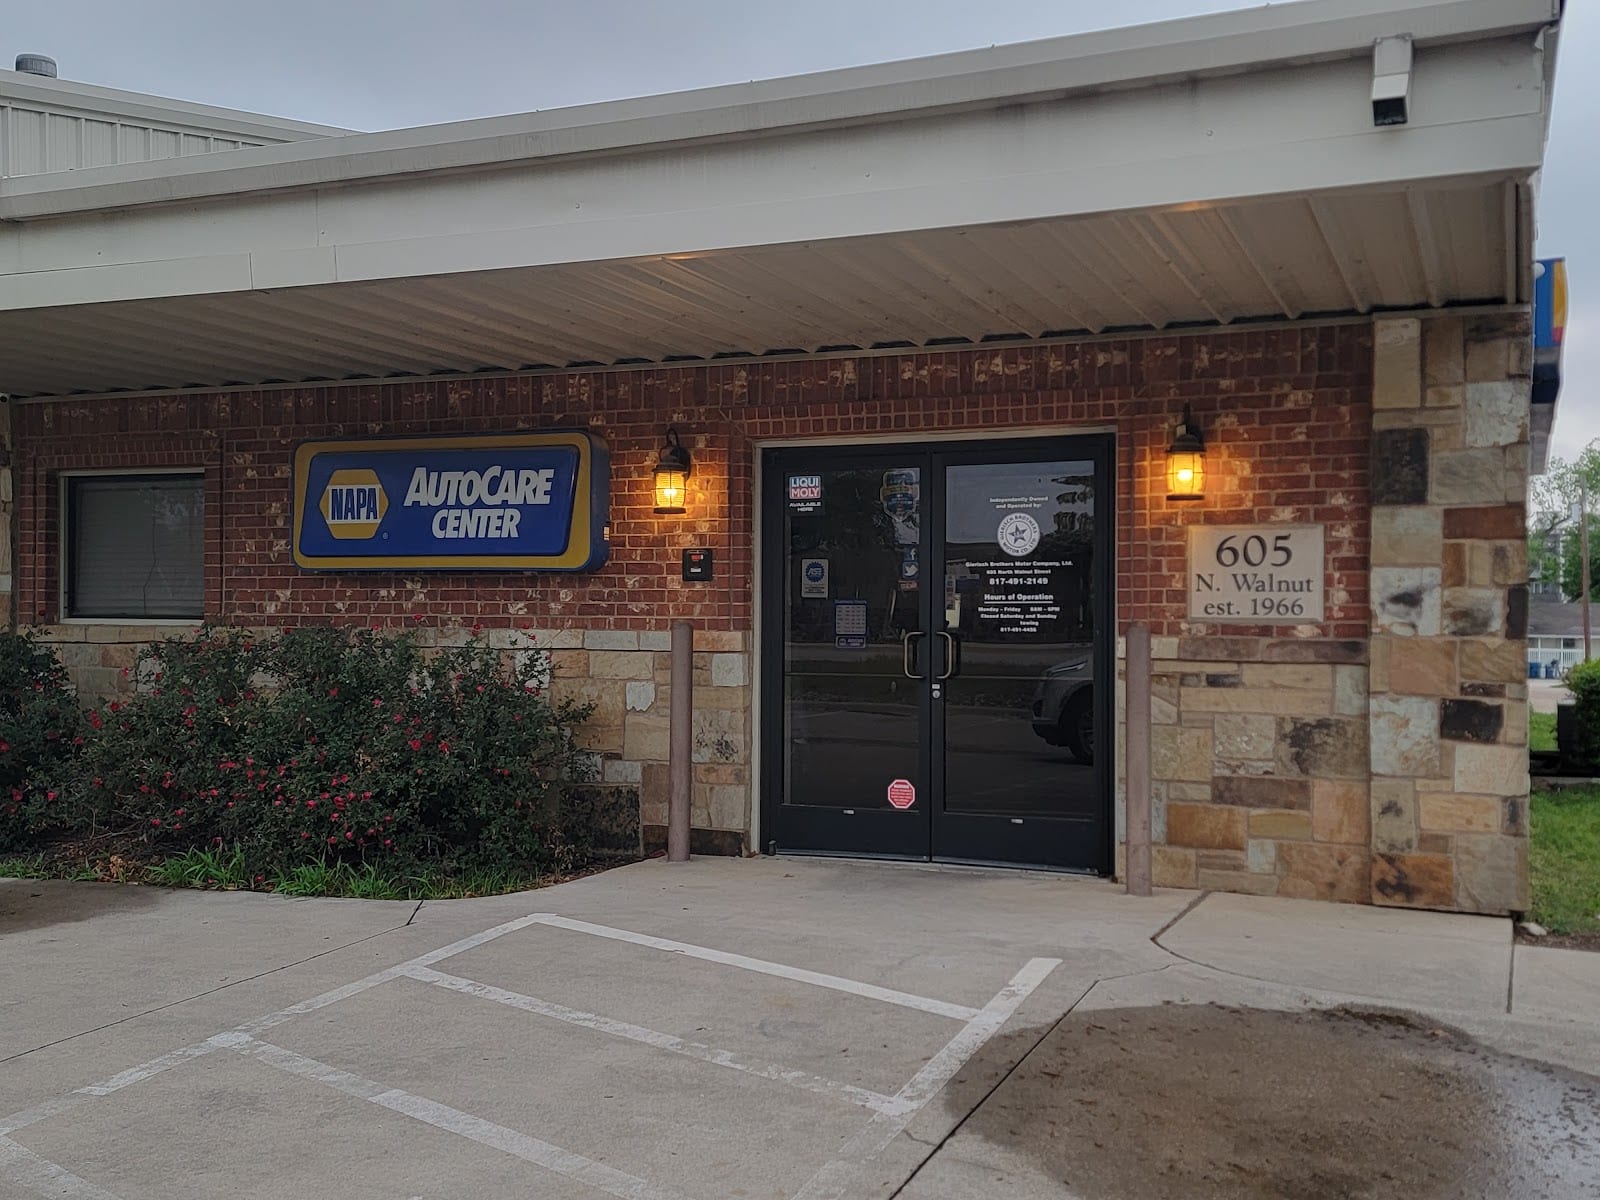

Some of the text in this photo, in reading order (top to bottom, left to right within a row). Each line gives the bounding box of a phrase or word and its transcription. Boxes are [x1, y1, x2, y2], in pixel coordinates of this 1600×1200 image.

[791, 477, 819, 487] LIQUI
[791, 488, 819, 497] MOLY
[331, 487, 378, 521] NAPA
[431, 508, 521, 539] CENTER
[1216, 533, 1293, 567] 605
[989, 577, 1049, 585] 817-491-2149
[1195, 573, 1314, 592] N. Walnut
[1016, 593, 1054, 601] Operation
[1204, 597, 1304, 616] est. 1966
